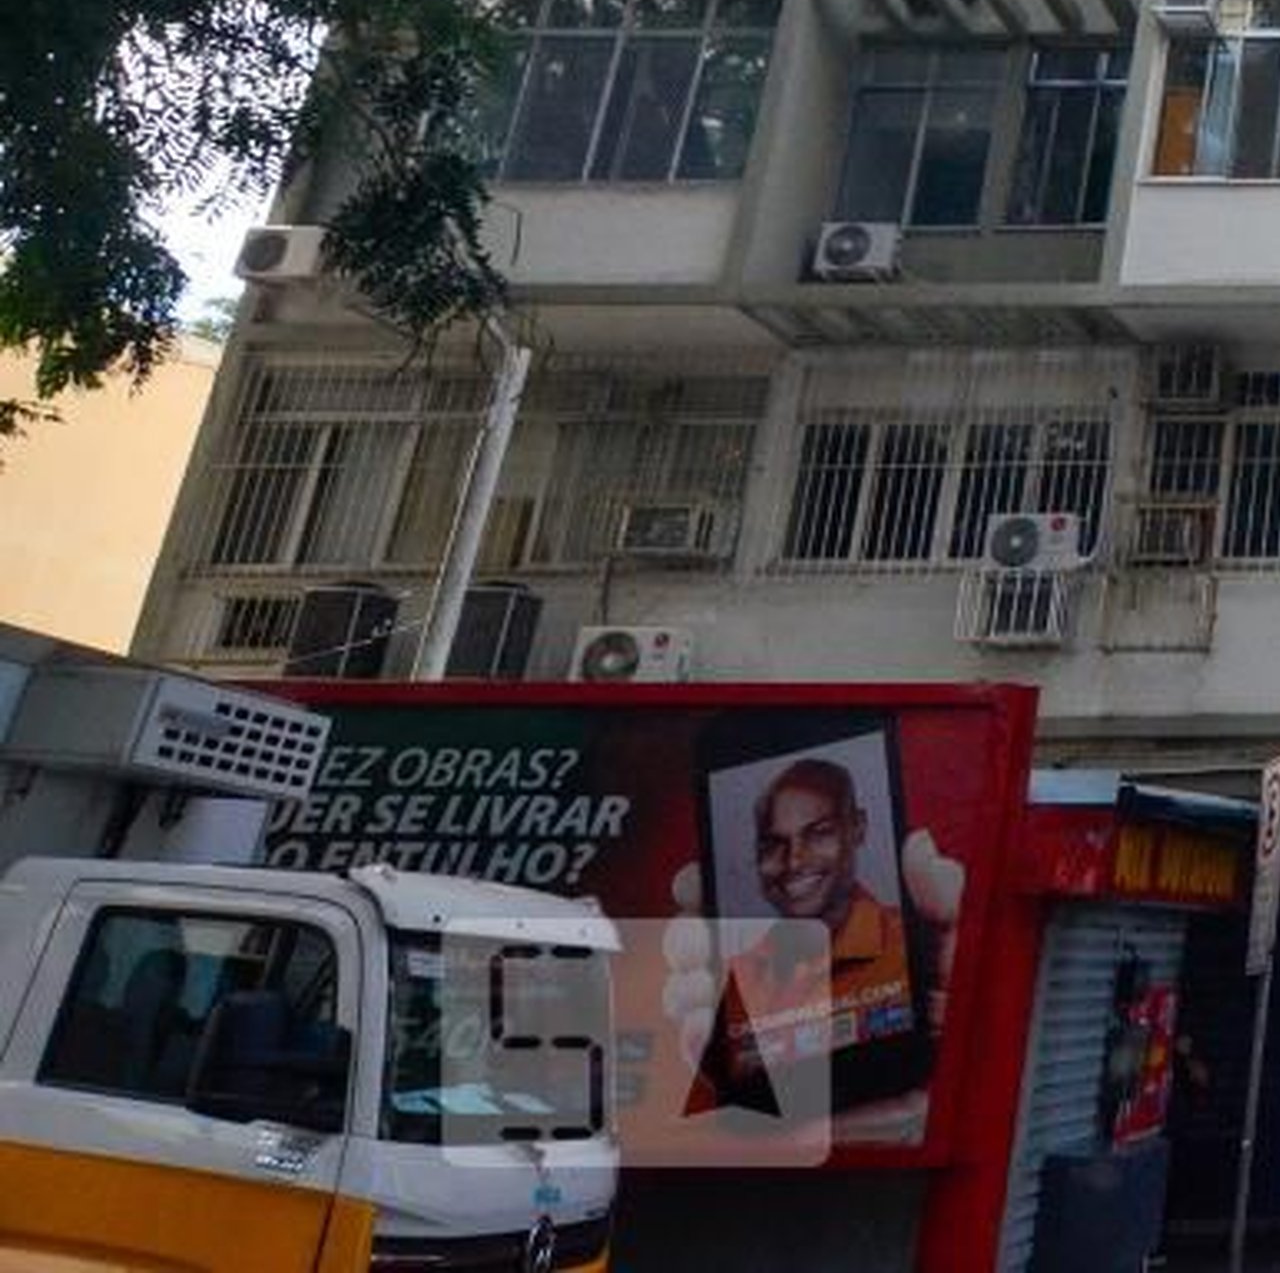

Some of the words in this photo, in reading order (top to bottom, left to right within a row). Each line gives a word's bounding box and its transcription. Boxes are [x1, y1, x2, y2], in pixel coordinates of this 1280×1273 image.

[317, 747, 385, 788] EZ
[388, 747, 580, 790] OBRAS?
[365, 794, 438, 835] SE
[437, 794, 631, 837] LIVRAR
